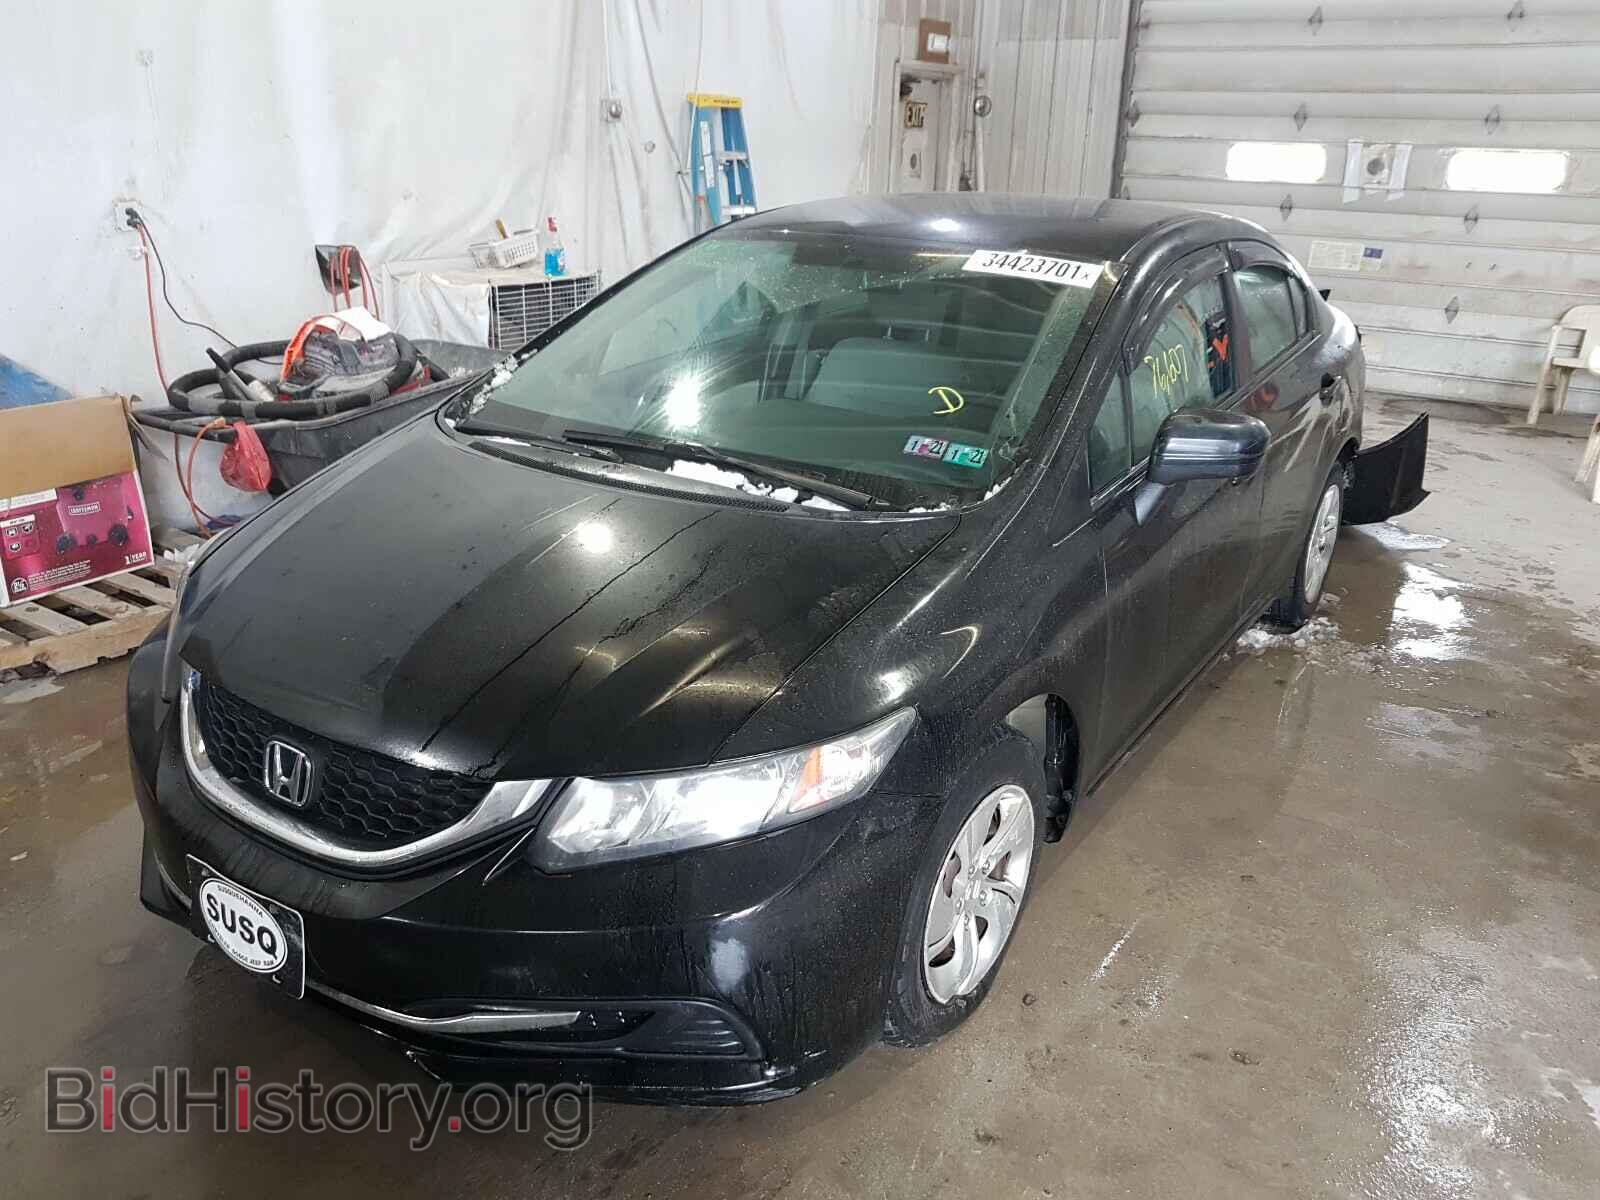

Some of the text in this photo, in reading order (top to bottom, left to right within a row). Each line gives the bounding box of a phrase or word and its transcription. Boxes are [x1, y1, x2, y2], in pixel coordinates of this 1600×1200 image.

[905, 103, 926, 127] EXIT
[982, 252, 1082, 280] 34423701
[927, 386, 965, 415] D
[928, 440, 945, 456] 21
[969, 449, 985, 465] 21
[206, 892, 278, 961] SUSQ
